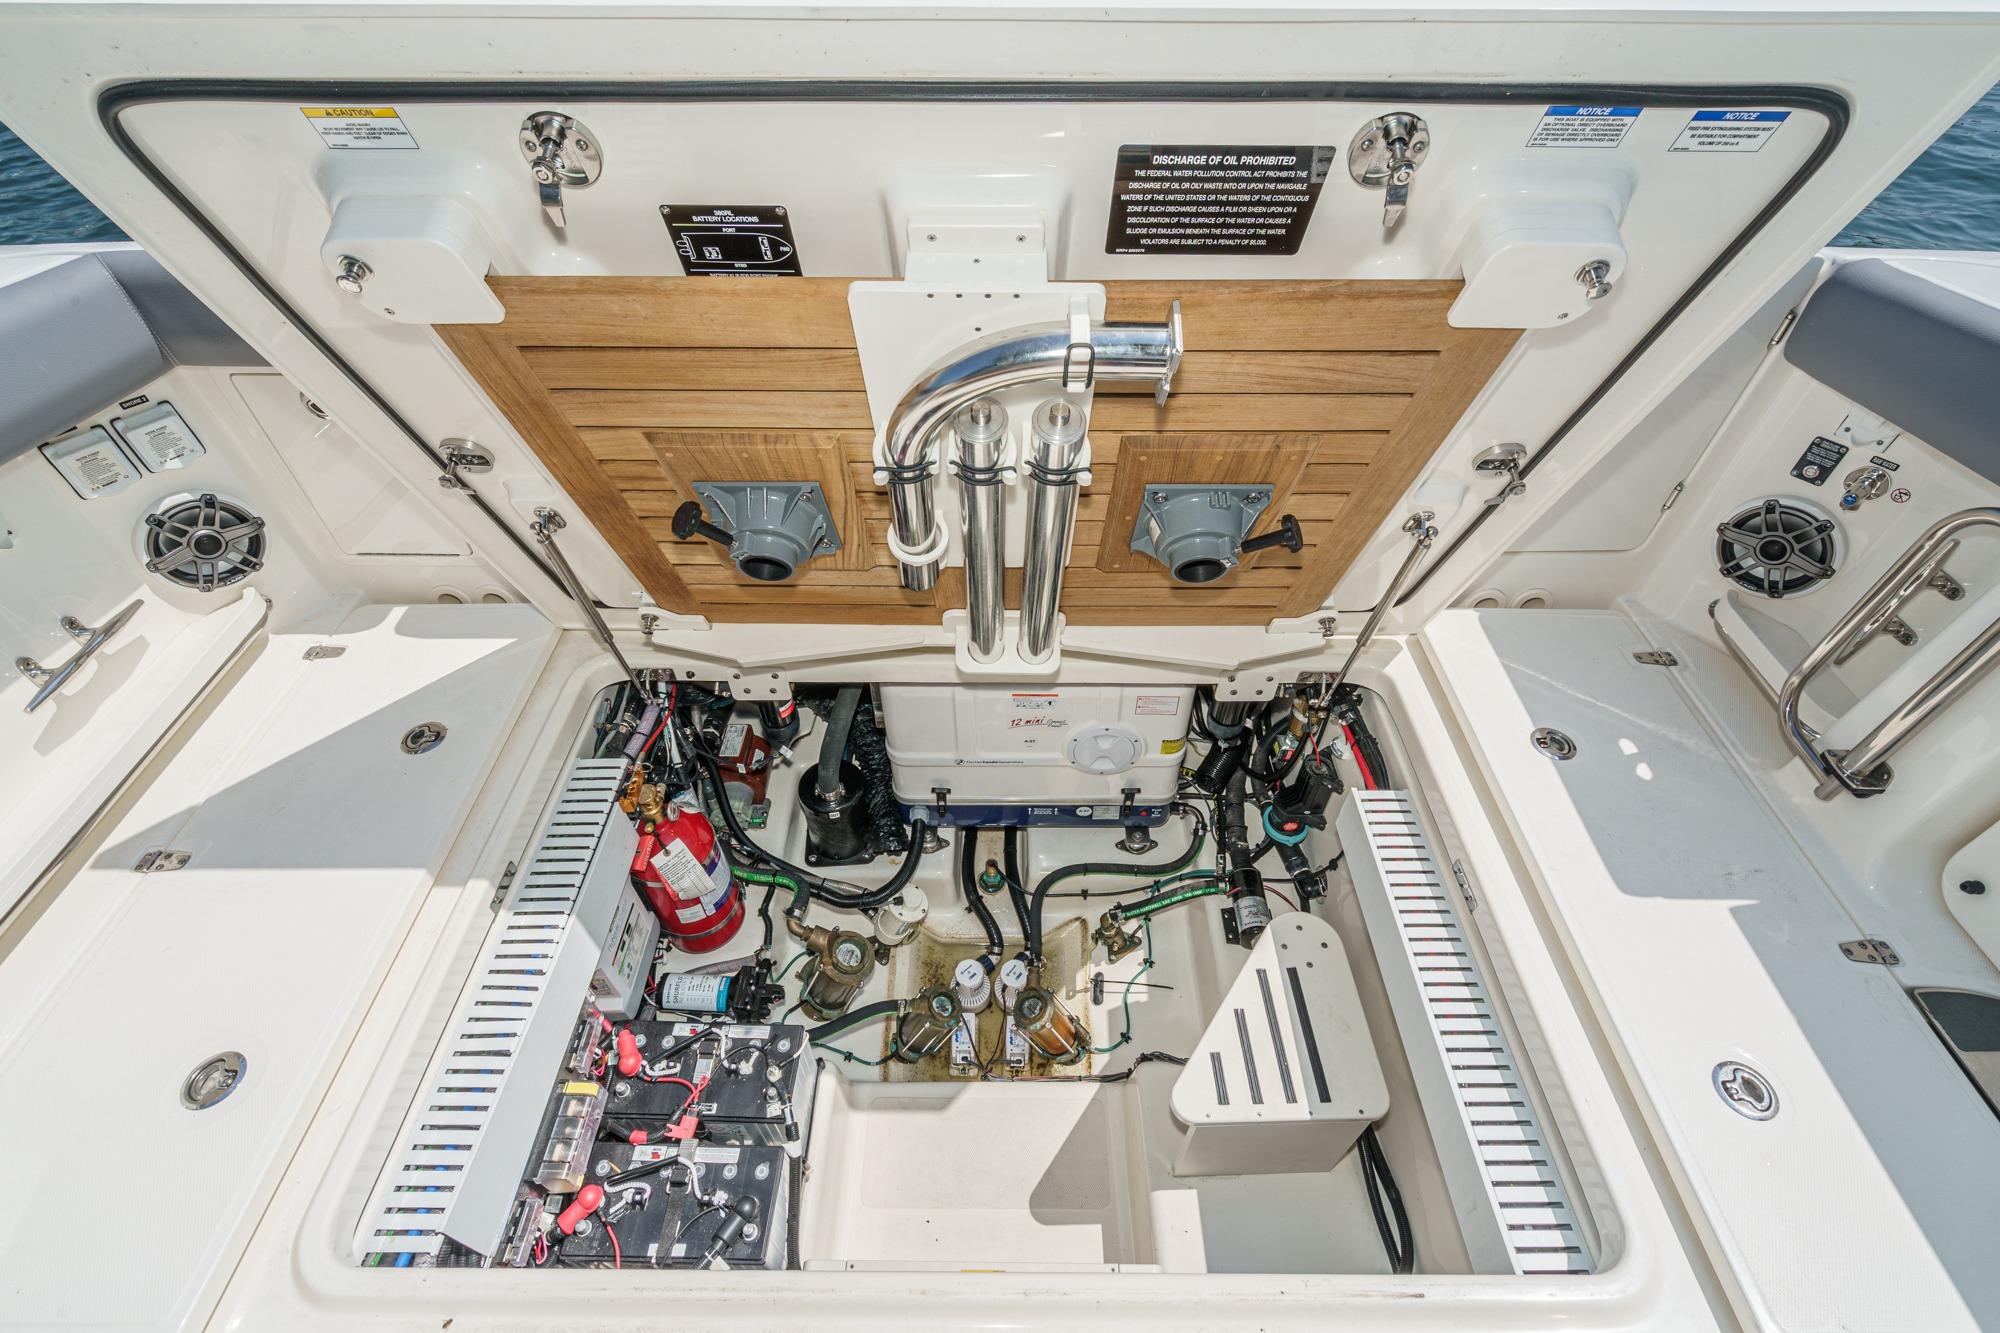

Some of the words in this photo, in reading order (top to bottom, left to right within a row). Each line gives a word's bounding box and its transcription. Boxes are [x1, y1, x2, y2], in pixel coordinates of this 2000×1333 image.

[1723, 112, 1760, 120] NOTICE
[1153, 156, 1207, 165] DISCHARGE
[1208, 156, 1222, 165] OF
[1223, 156, 1238, 165] OIL
[1240, 156, 1296, 165] PROHIBITED
[1010, 718, 1022, 727] 12
[1025, 716, 1046, 725] mini
